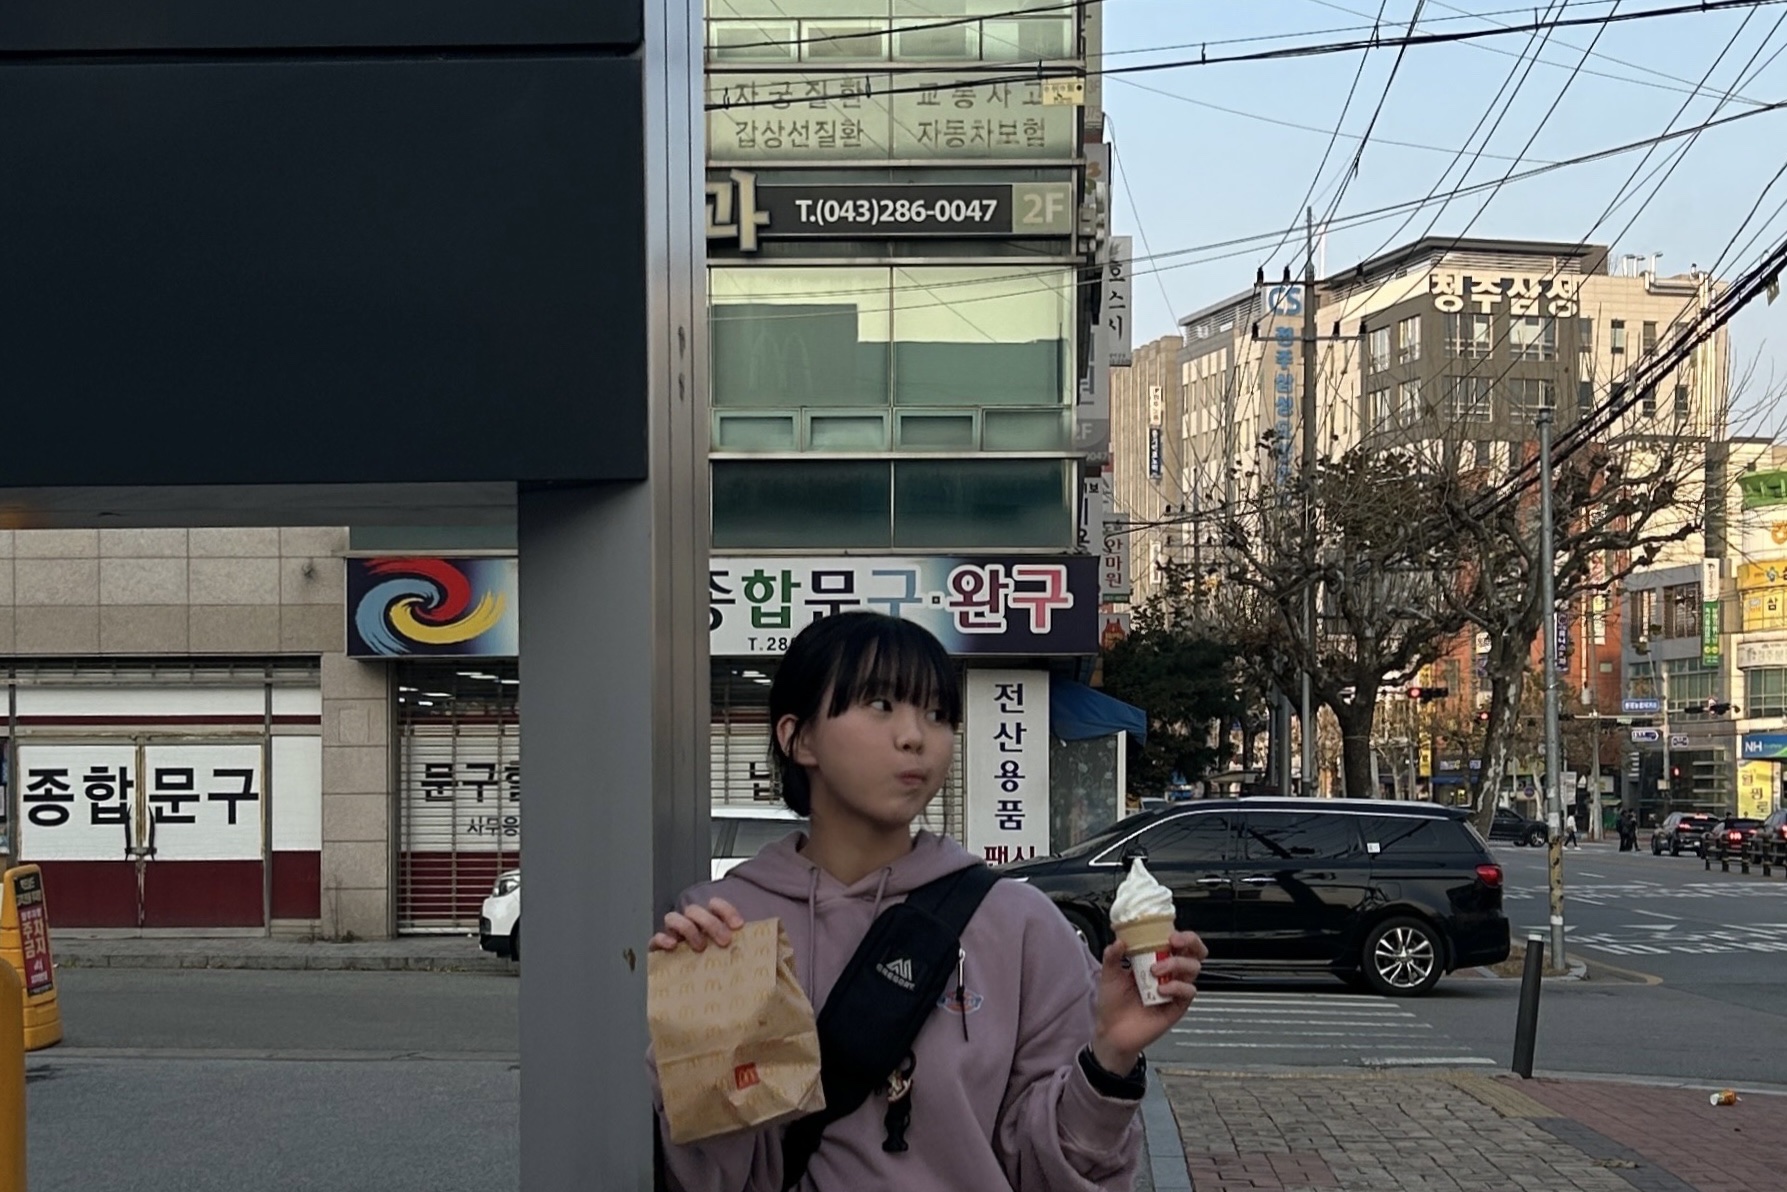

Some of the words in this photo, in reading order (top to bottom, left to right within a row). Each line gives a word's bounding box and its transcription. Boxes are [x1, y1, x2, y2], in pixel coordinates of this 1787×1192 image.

[735, 119, 865, 149] 갑상선질환
[917, 117, 1046, 149] 자동차보험
[795, 199, 997, 226] T.(043)286-0047
[1022, 193, 1064, 224] 2F
[1268, 286, 1303, 316] CS
[1105, 538, 1123, 588] 안마원
[993, 683, 1027, 831] 전산용품
[1744, 741, 1763, 753] NH
[23, 766, 259, 827] 종합문구
